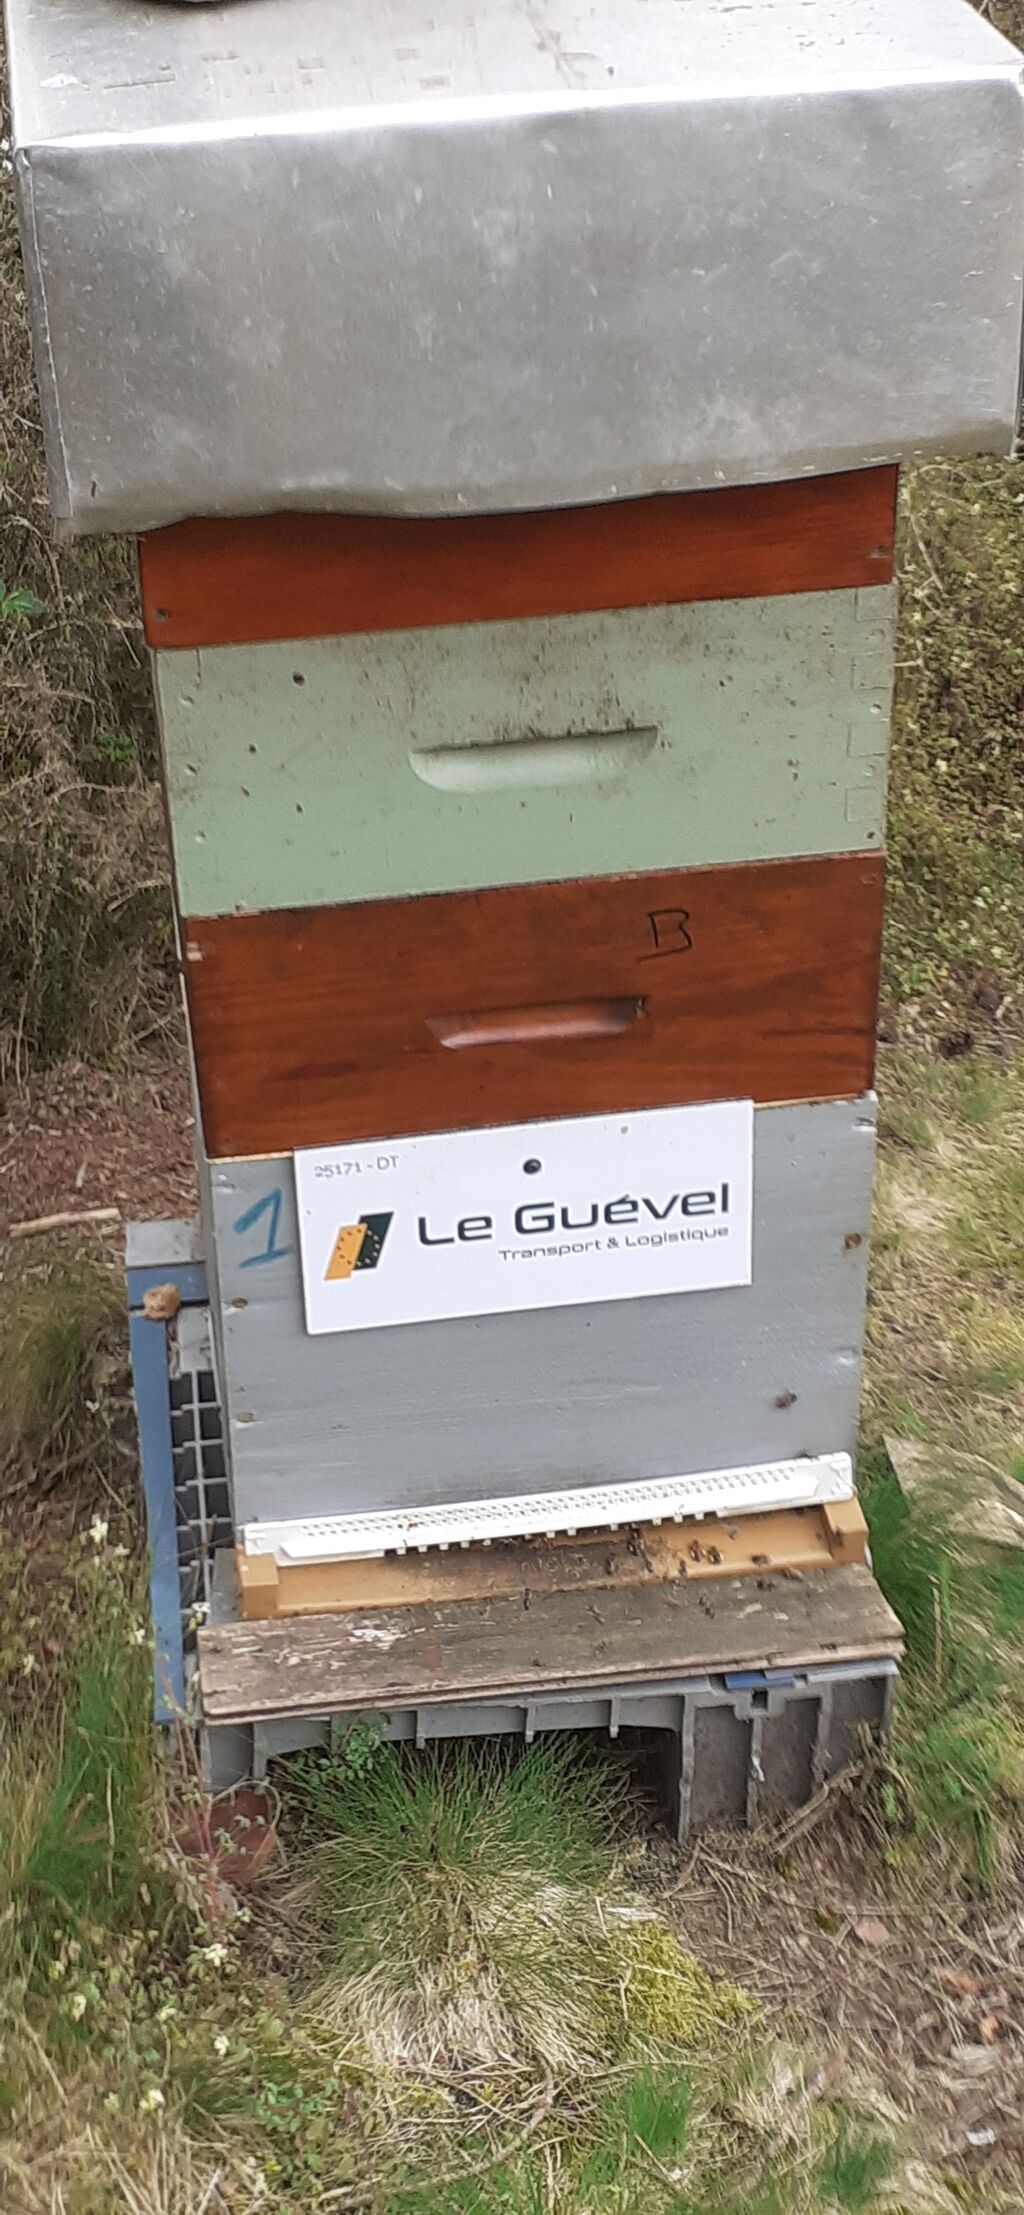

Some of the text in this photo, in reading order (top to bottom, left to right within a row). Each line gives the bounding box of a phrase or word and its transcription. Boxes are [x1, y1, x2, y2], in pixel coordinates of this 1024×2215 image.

[232, 1187, 293, 1269] 1
[417, 1182, 730, 1246] Le Guével
[499, 1226, 730, 1262] Transport & Logistique
